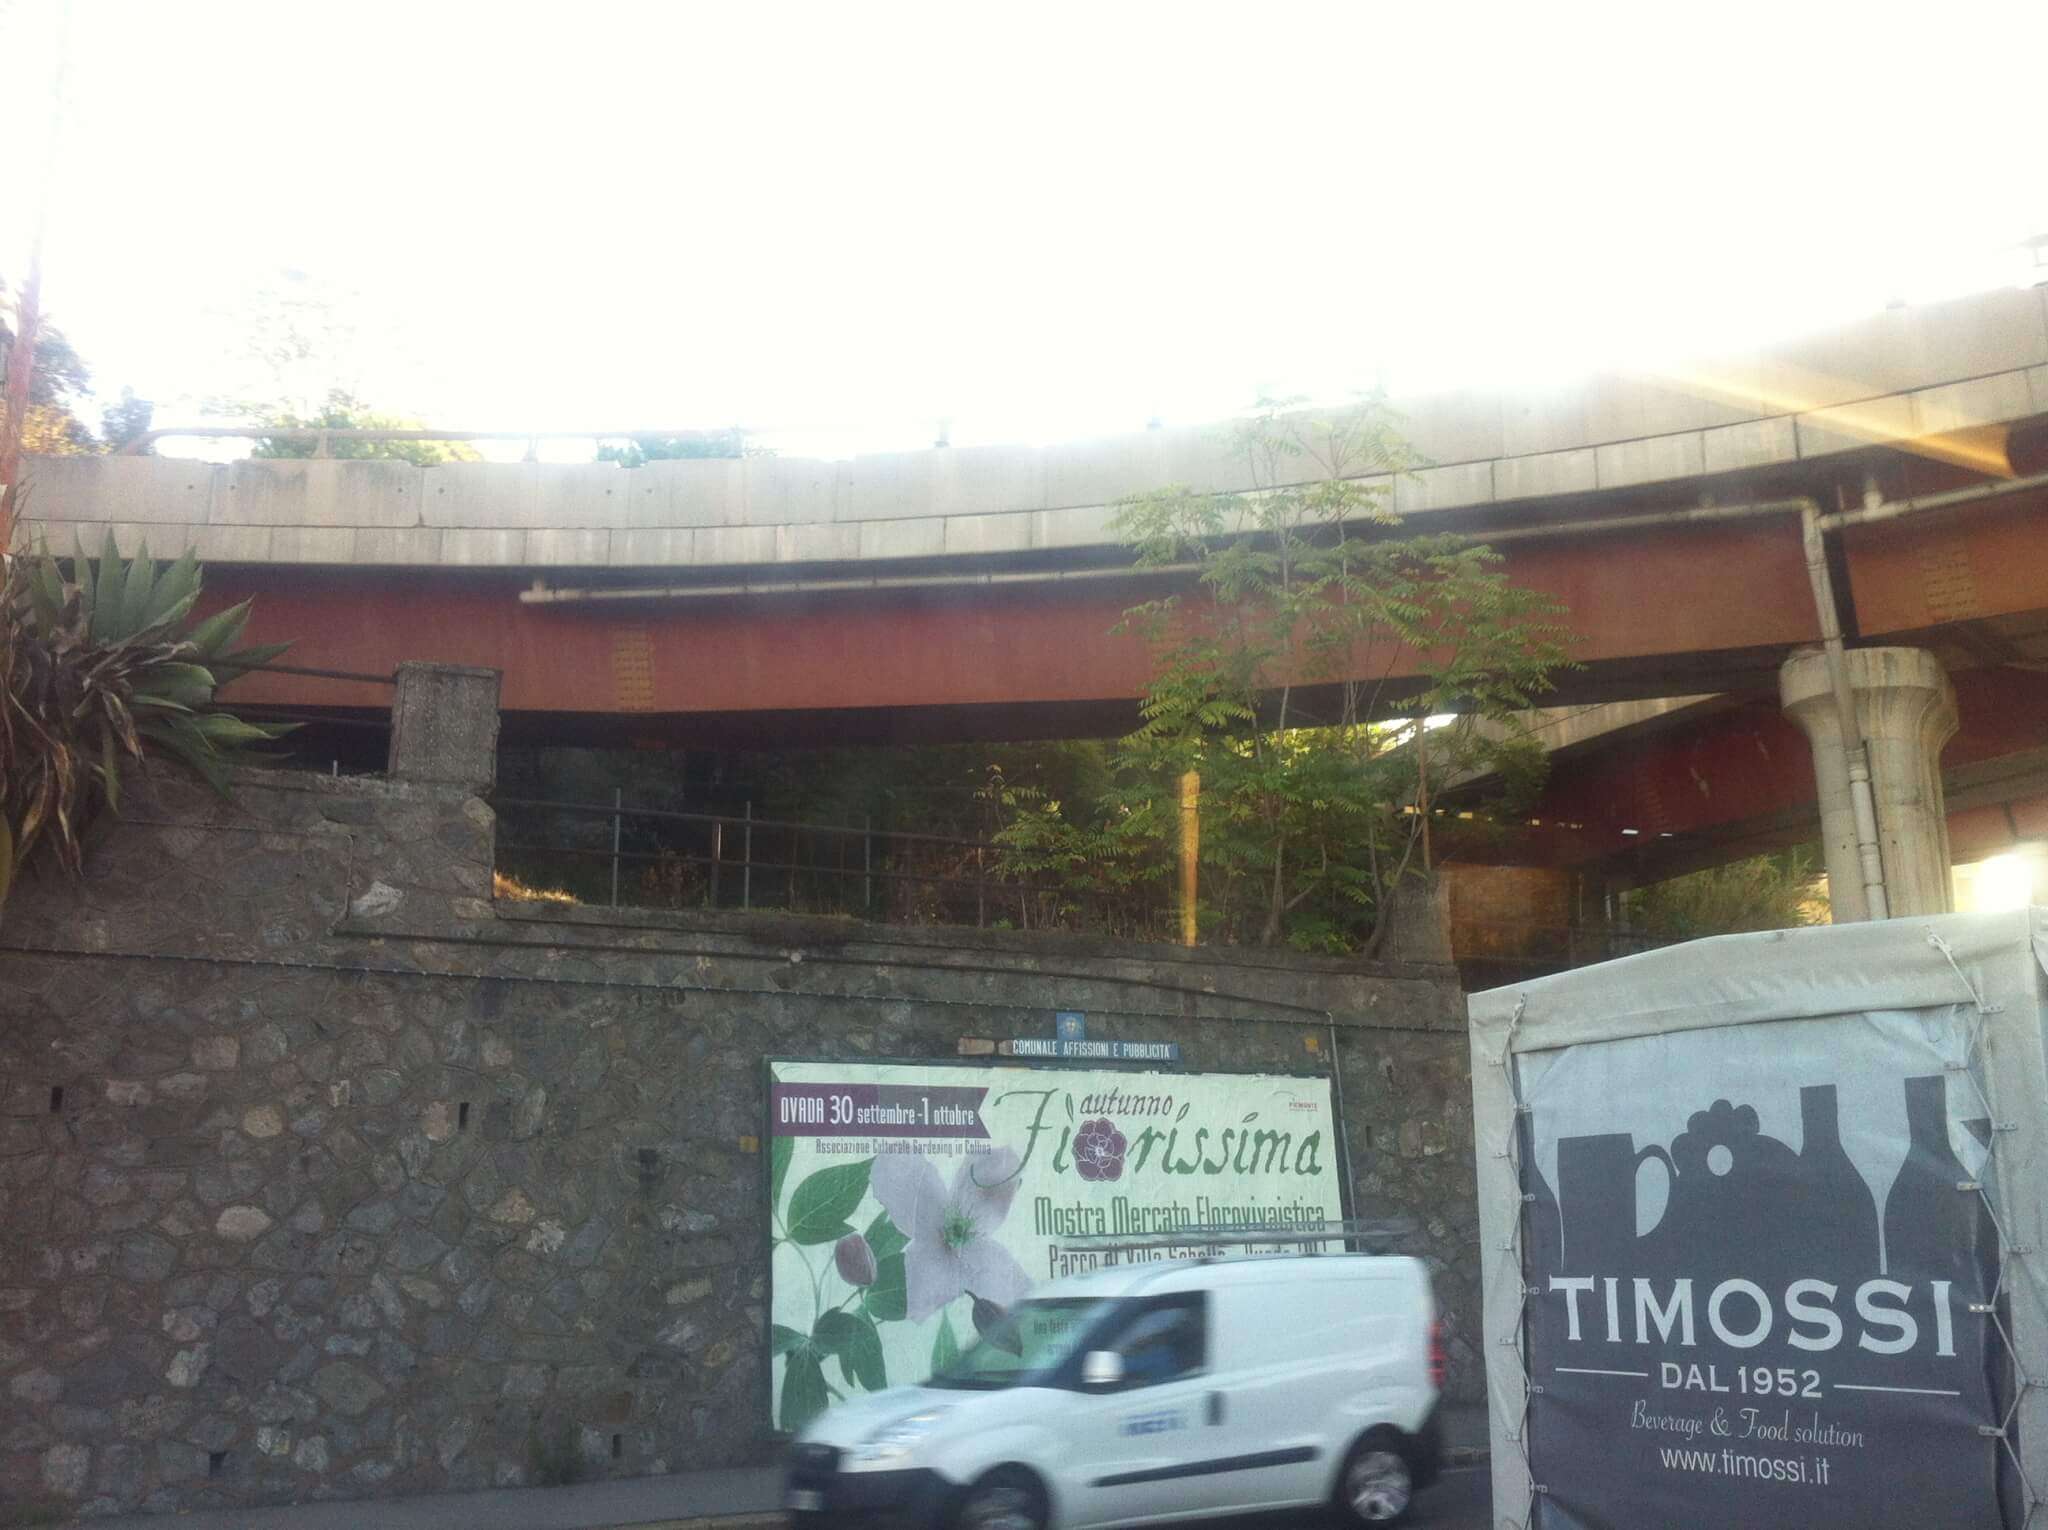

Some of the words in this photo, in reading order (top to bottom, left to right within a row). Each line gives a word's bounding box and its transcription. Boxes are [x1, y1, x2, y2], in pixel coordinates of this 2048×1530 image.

[1012, 1039, 1057, 1056] COMUNALE
[1063, 1041, 1109, 1057] AFFISSIONI
[1113, 1042, 1119, 1057] E
[780, 1096, 824, 1124] OVADA
[829, 1094, 853, 1125] 30
[857, 1103, 915, 1125] settembre
[934, 1103, 974, 1126] ottobre
[816, 1138, 870, 1155] Associazione
[872, 1138, 910, 1155] Culturale
[1034, 1196, 1106, 1236] Mostra
[1112, 1196, 1190, 1234] Mercato
[1049, 1244, 1097, 1279] Parco
[1549, 1274, 1957, 1357] TIMOSSI
[1661, 1362, 1729, 1393] DAL
[1738, 1366, 1823, 1399] 1952
[1631, 1399, 1703, 1441] Beverage
[1710, 1406, 1732, 1437] &
[1738, 1408, 1790, 1443] Food
[1794, 1411, 1864, 1449] solution
[1660, 1447, 1830, 1485] www.timossi.it
